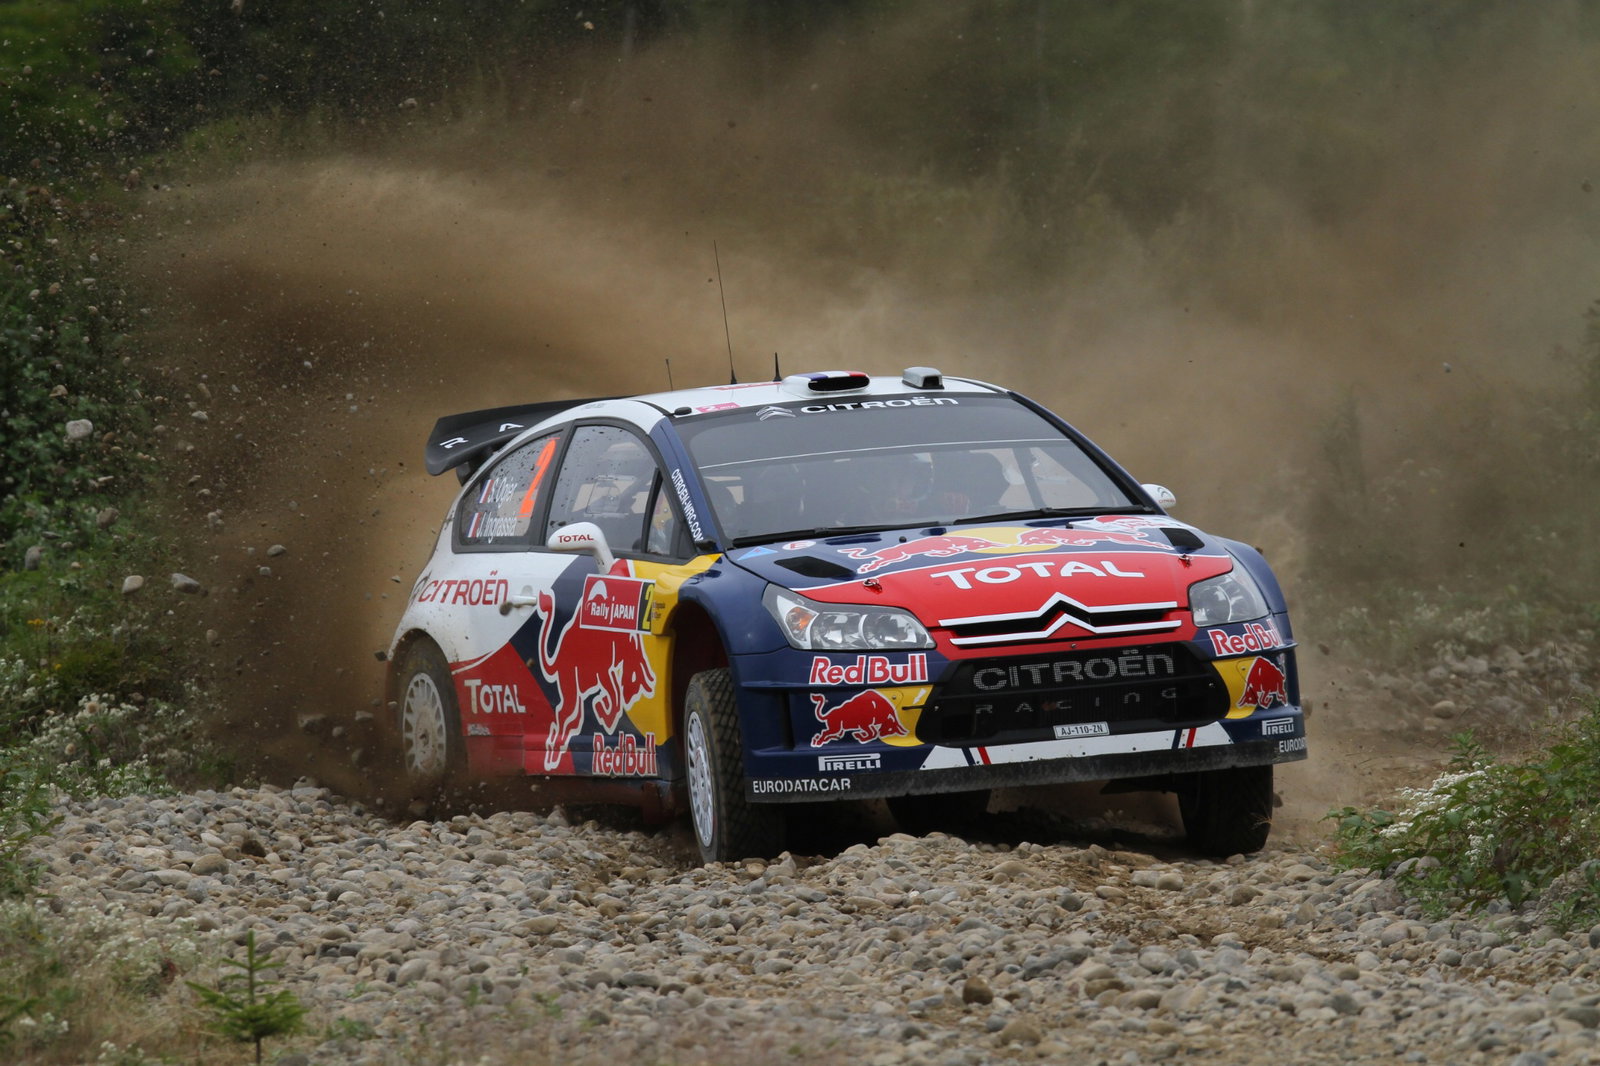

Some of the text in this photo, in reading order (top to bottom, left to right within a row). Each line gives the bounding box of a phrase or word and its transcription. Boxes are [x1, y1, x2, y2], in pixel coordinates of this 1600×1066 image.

[557, 534, 595, 543] TOTAL
[930, 560, 1145, 590] TOTAL
[590, 602, 610, 620] Rally
[642, 584, 655, 629] 2
[1207, 623, 1262, 657] Red
[809, 653, 928, 685] Red Bull
[464, 678, 527, 714] TOTAL
[1061, 724, 1103, 735] AJ-110-ZN
[1262, 717, 1294, 735] PIRELLI
[592, 731, 658, 777] Red Bull
[818, 752, 881, 771] PIRELLI
[752, 777, 851, 794] EURODATACAR
